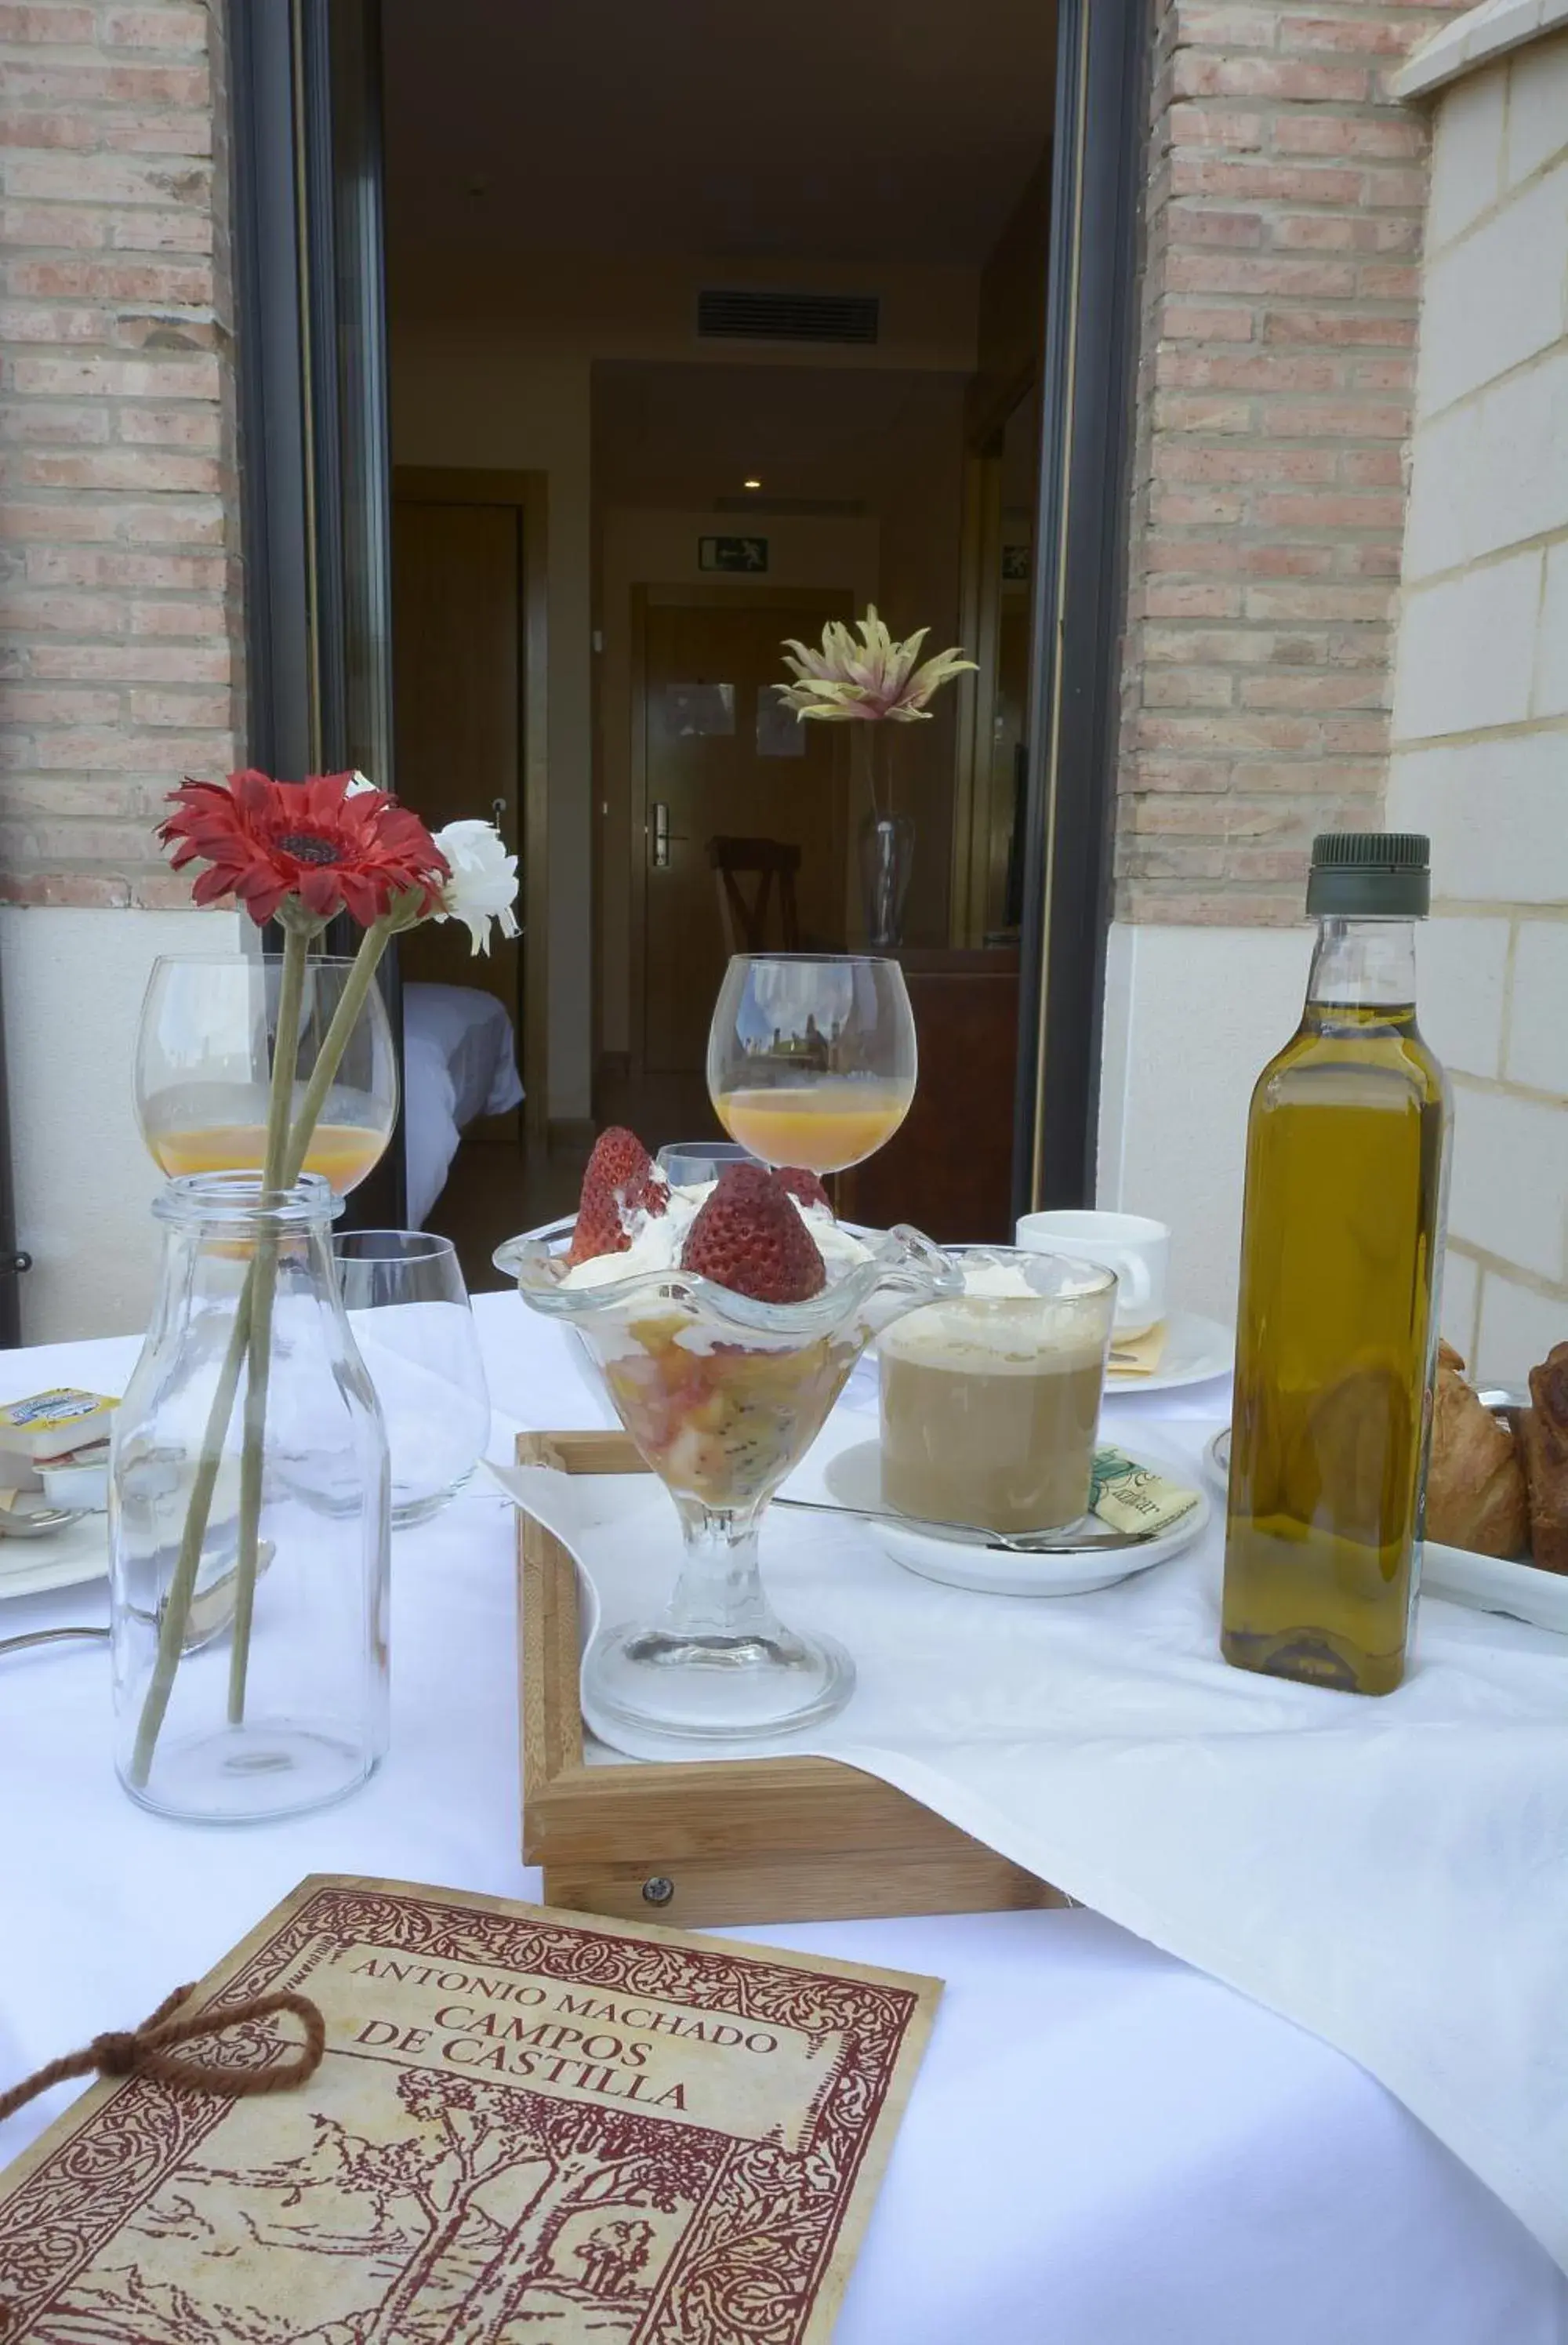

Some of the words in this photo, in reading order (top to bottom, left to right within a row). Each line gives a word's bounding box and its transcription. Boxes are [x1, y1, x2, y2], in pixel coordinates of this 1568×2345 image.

[350, 1958, 547, 2005] ANTONIO
[553, 1994, 779, 2054] MACHADO
[433, 2005, 652, 2067] CAMPOS
[354, 2020, 432, 2054] DE
[441, 2037, 688, 2112] CASTILLA
